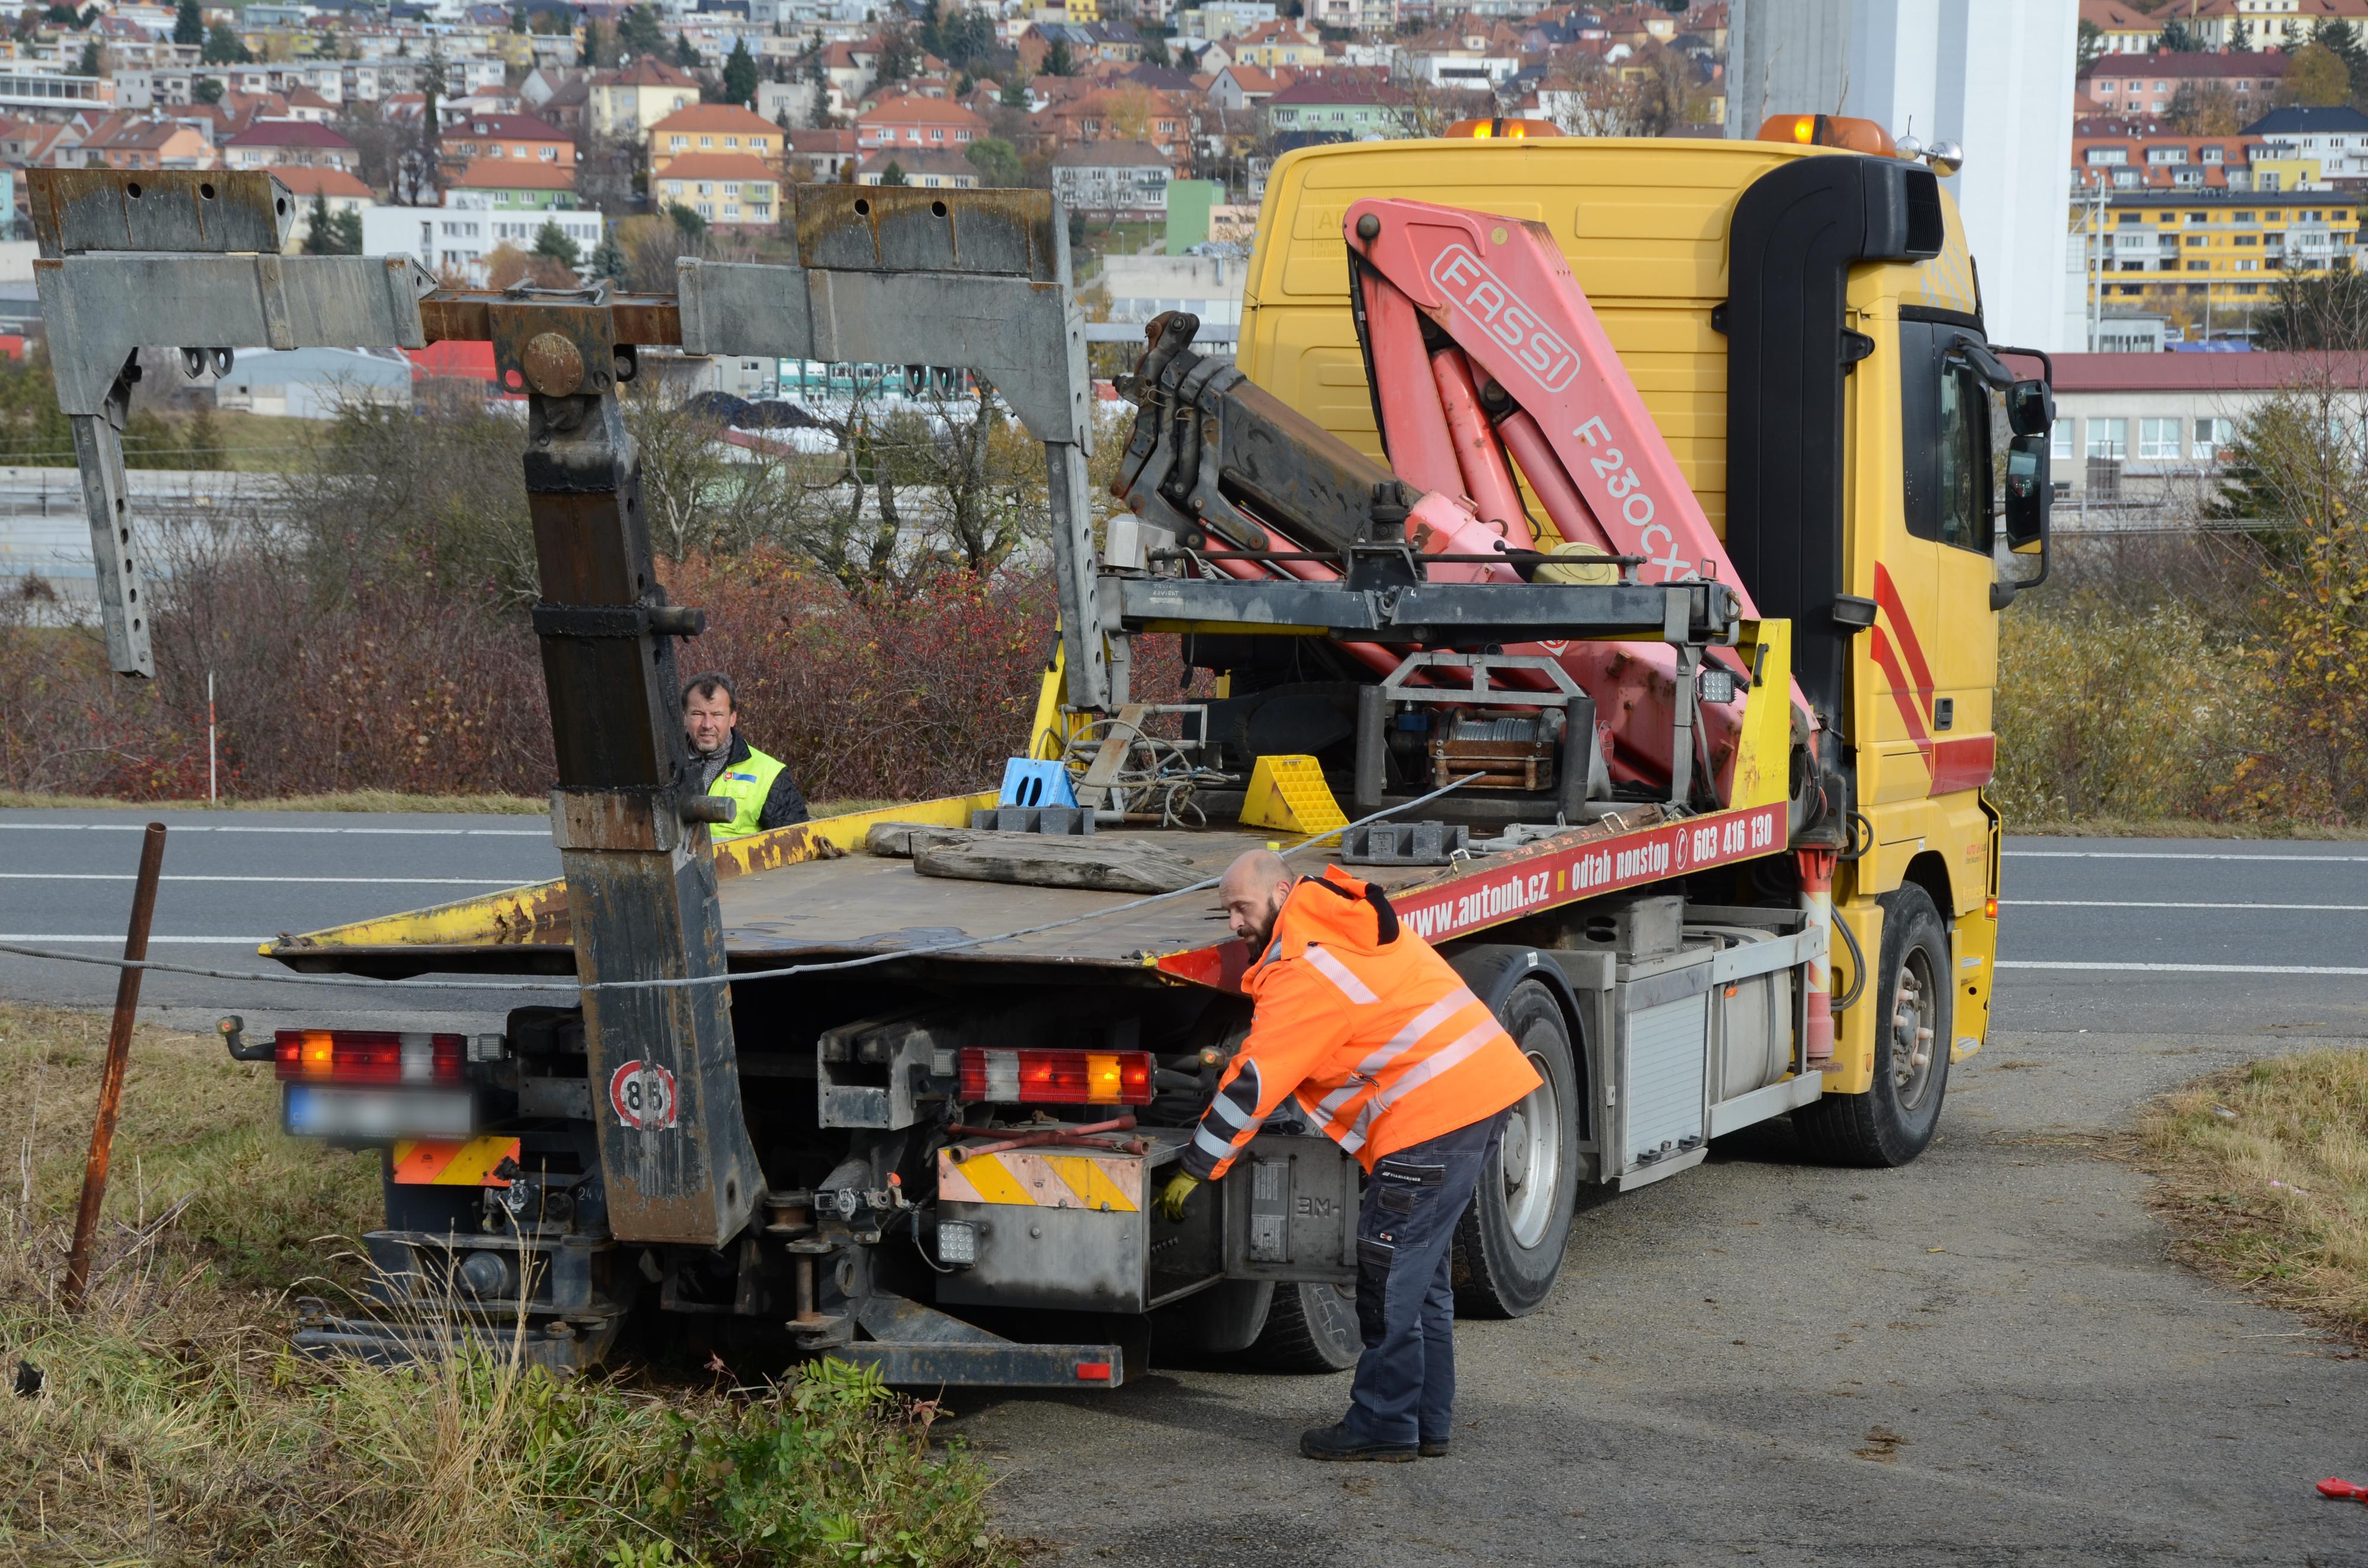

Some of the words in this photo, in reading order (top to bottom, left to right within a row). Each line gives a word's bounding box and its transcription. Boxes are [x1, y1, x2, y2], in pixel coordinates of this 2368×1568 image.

[1441, 255, 1569, 382] FASSI
[1572, 850, 1611, 891] odtah
[1616, 841, 1669, 880] nonstop
[1693, 826, 1717, 863] 603
[1723, 819, 1745, 855] 416
[1751, 813, 1772, 849] 130
[578, 1187, 592, 1201] 24
[594, 1188, 604, 1203] V
